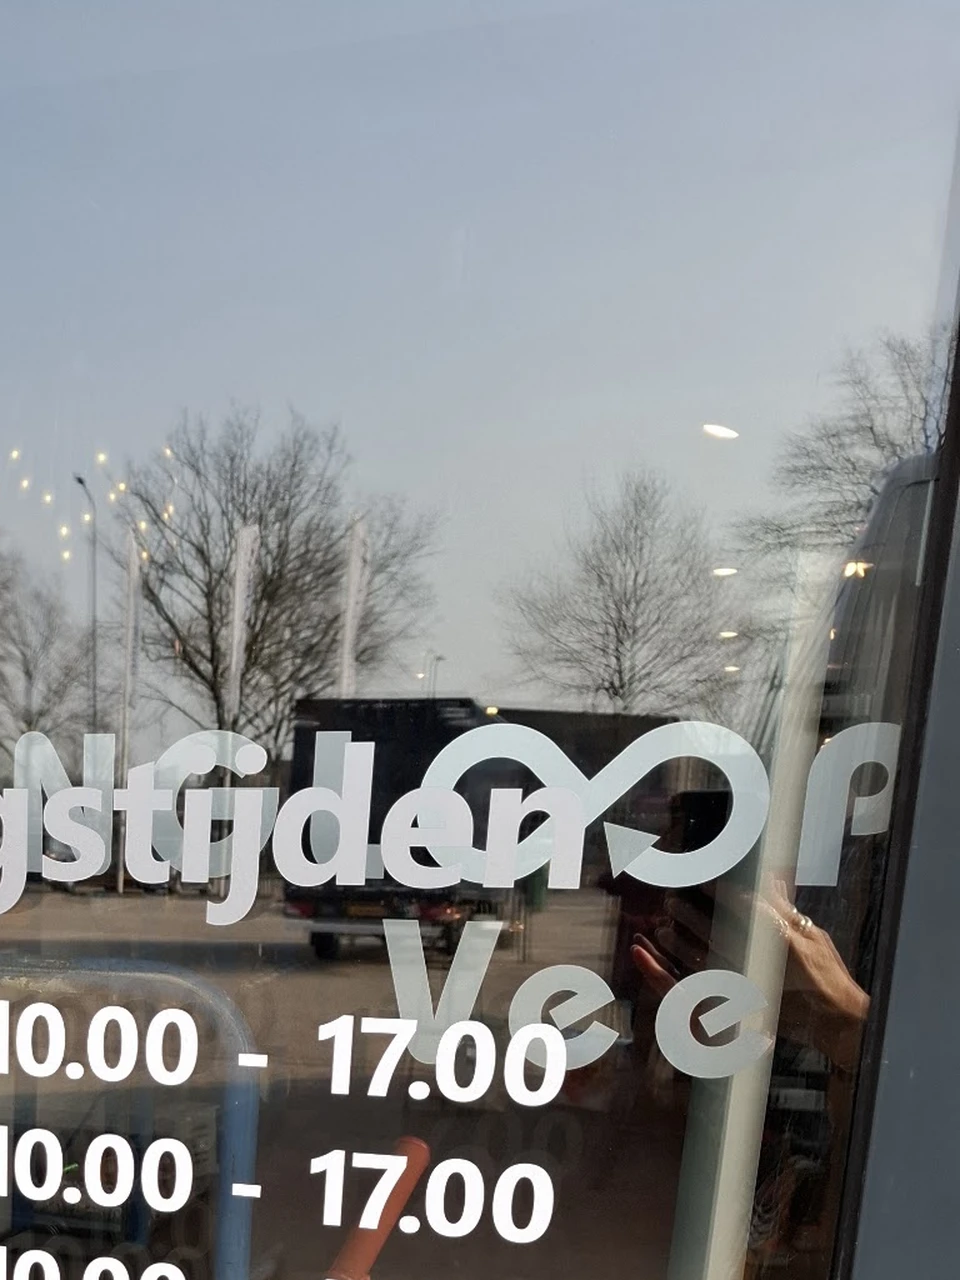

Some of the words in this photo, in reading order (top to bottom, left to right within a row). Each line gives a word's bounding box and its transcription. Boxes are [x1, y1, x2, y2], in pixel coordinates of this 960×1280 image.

[239, 1054, 267, 1066] -
[319, 1015, 566, 1105] 17.00
[233, 1184, 261, 1197] -
[311, 1150, 553, 1242] 17.00
